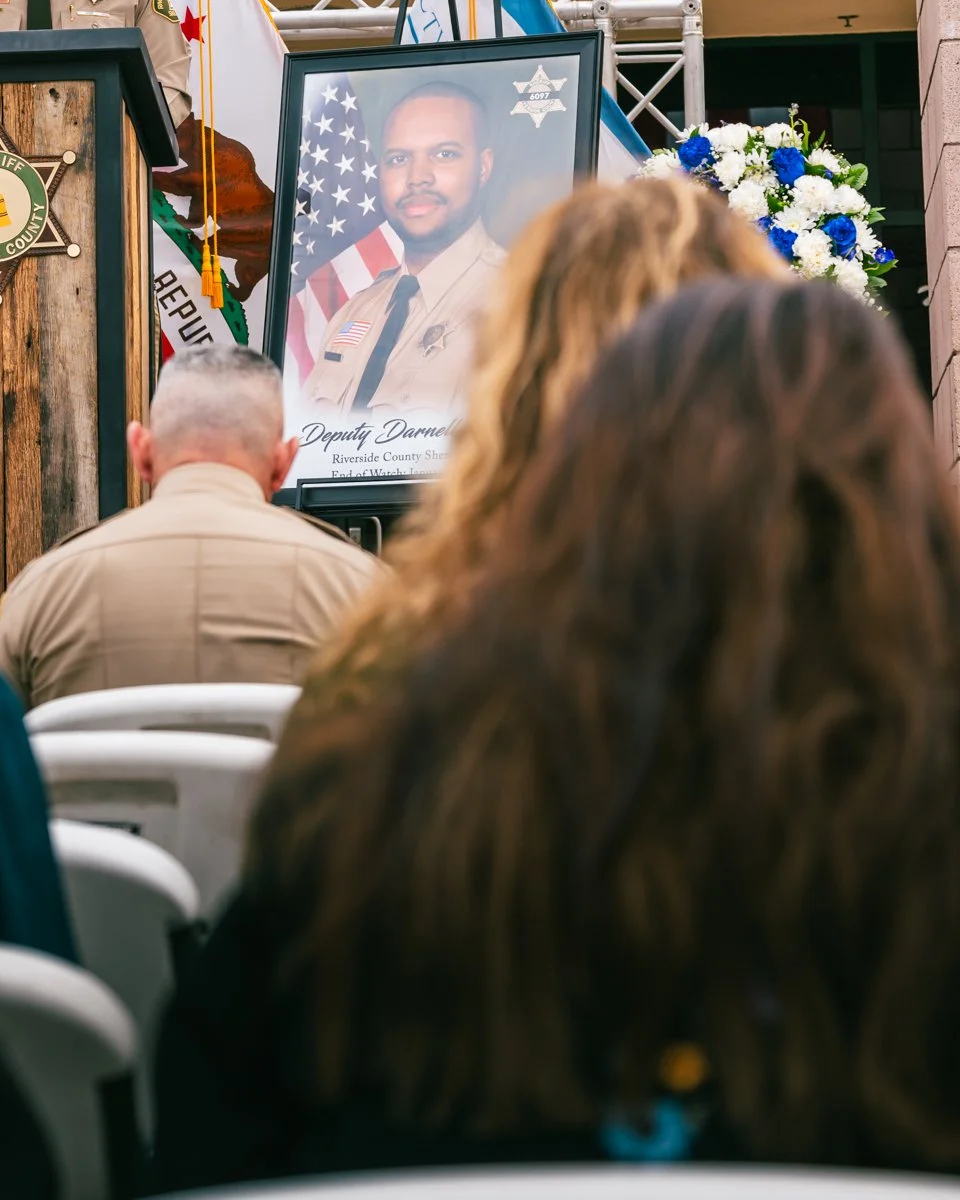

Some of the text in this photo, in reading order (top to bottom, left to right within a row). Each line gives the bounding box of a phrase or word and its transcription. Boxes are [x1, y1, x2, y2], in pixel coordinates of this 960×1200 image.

[529, 92, 550, 101] 6097
[5, 202, 45, 255] COUNTY
[299, 422, 375, 452] Deputy
[332, 453, 380, 464] Riverside
[383, 451, 421, 463] County
